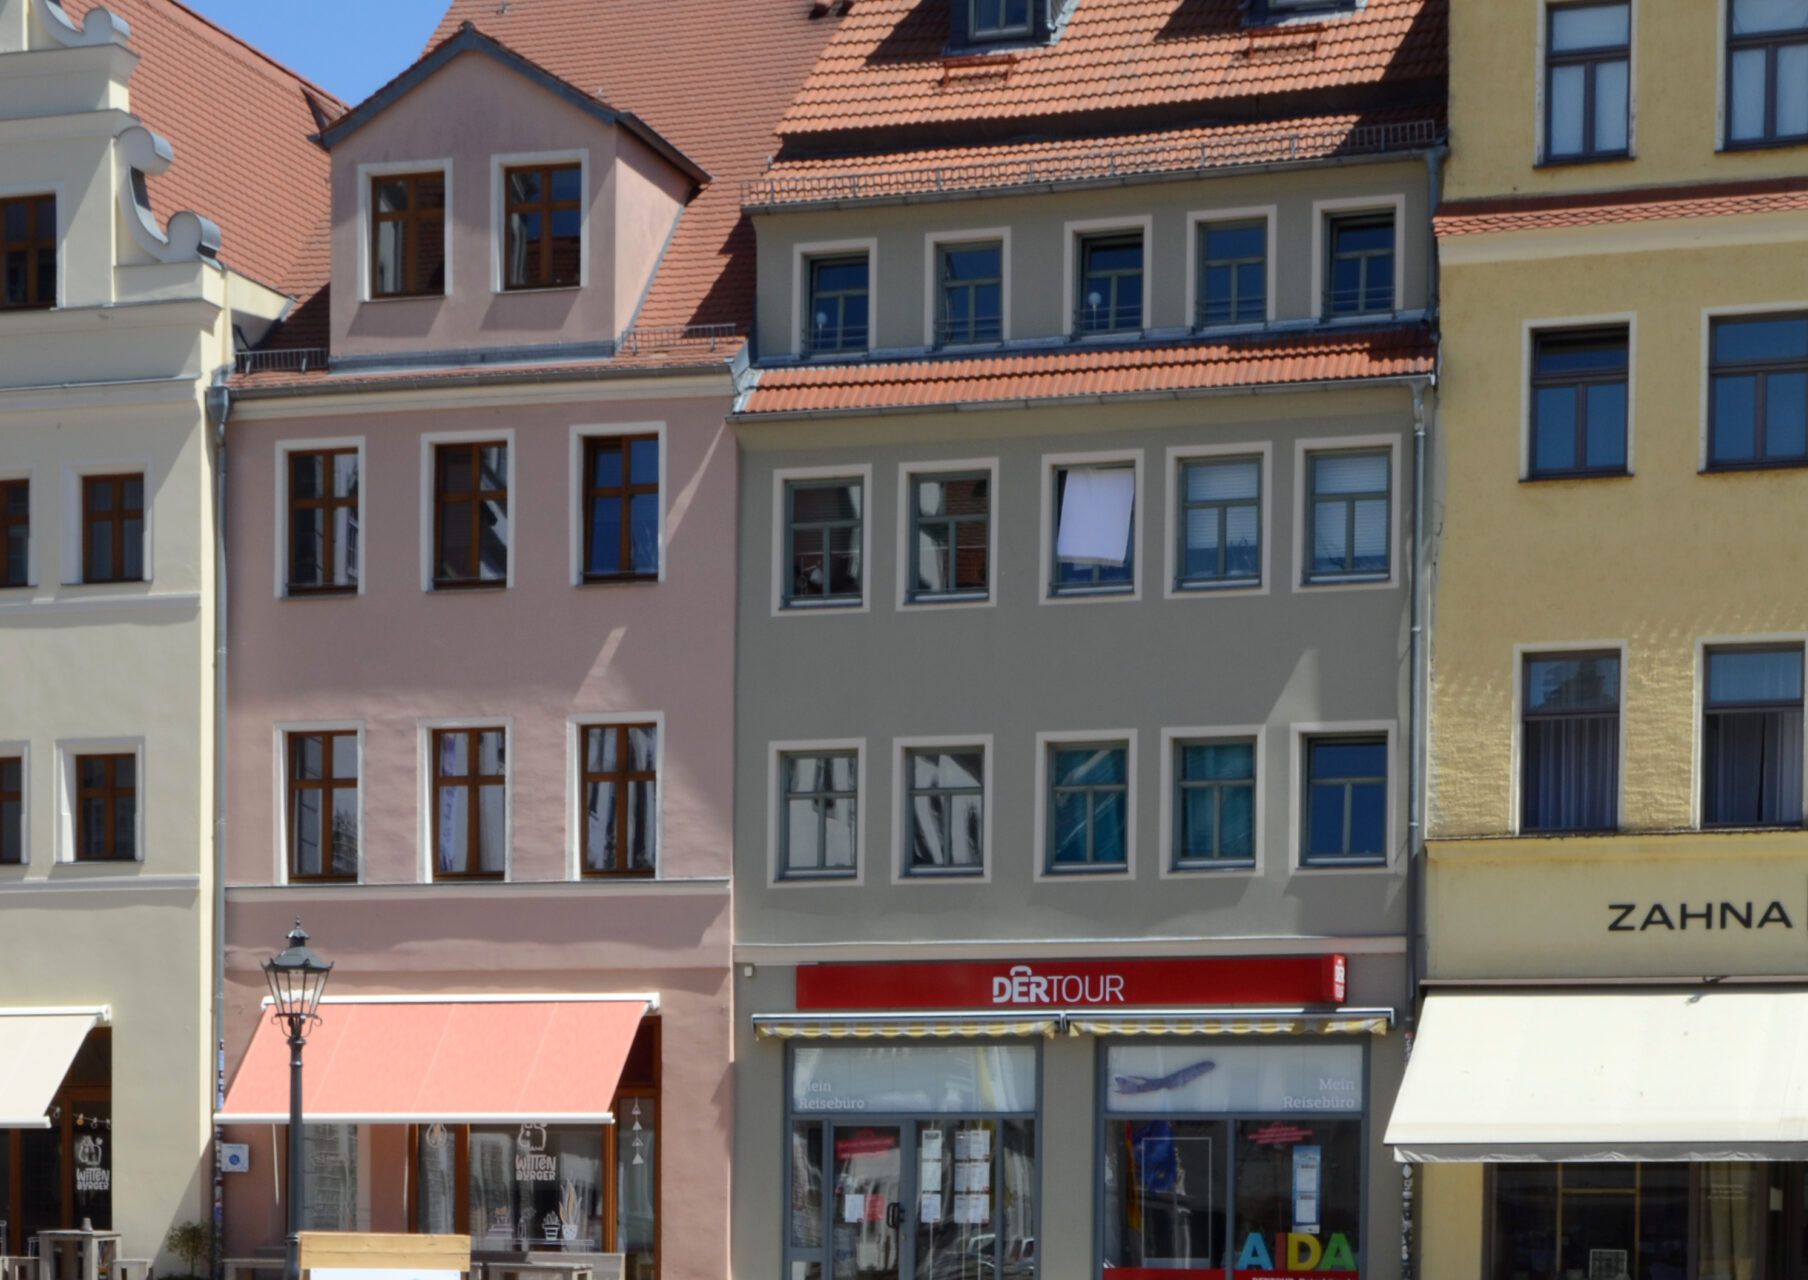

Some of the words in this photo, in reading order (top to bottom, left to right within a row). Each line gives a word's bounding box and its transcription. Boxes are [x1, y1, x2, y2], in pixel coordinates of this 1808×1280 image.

[1608, 901, 1793, 931] ZAHNA
[992, 973, 1125, 1003] DERTOUR
[1319, 1078, 1355, 1091] Mein
[800, 1096, 865, 1109] Reisebüro
[1283, 1095, 1355, 1109] Reisebüro
[516, 1170, 557, 1181] BURGER
[1236, 1231, 1358, 1271] AIDA
